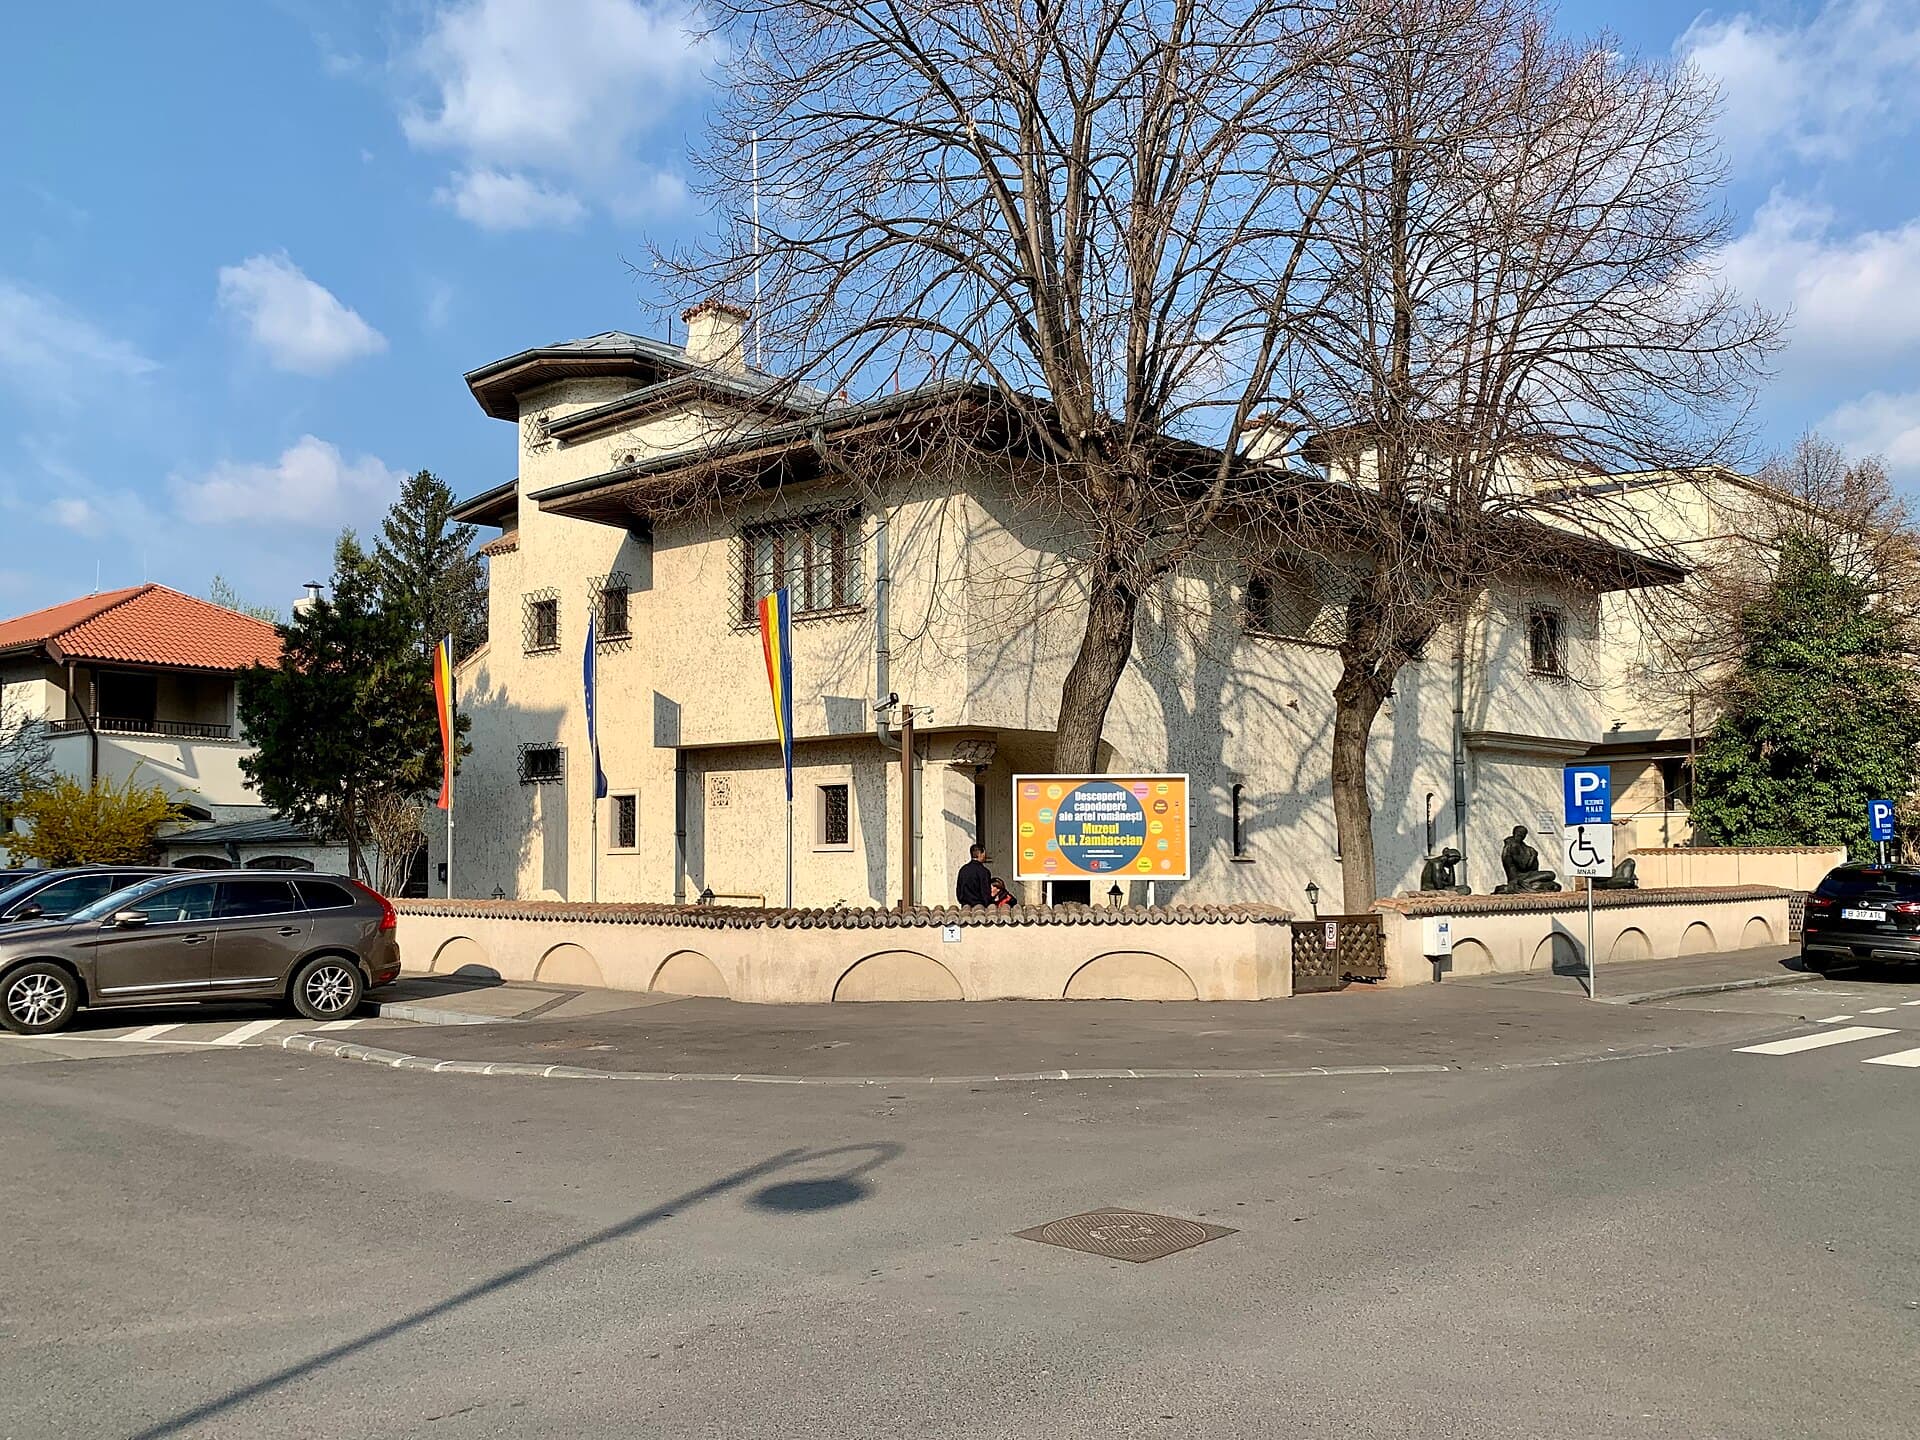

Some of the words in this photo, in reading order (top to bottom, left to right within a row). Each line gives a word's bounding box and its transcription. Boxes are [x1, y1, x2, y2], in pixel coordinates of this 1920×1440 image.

[1574, 772, 1600, 806] P
[1073, 802, 1127, 812] capodopere
[1058, 811, 1073, 821] ale
[1074, 811, 1096, 821] artei
[1874, 804, 1888, 828] P
[1082, 822, 1119, 834] Muzeul
[1058, 834, 1078, 846] K.H.
[1079, 834, 1143, 846] Zambaccian
